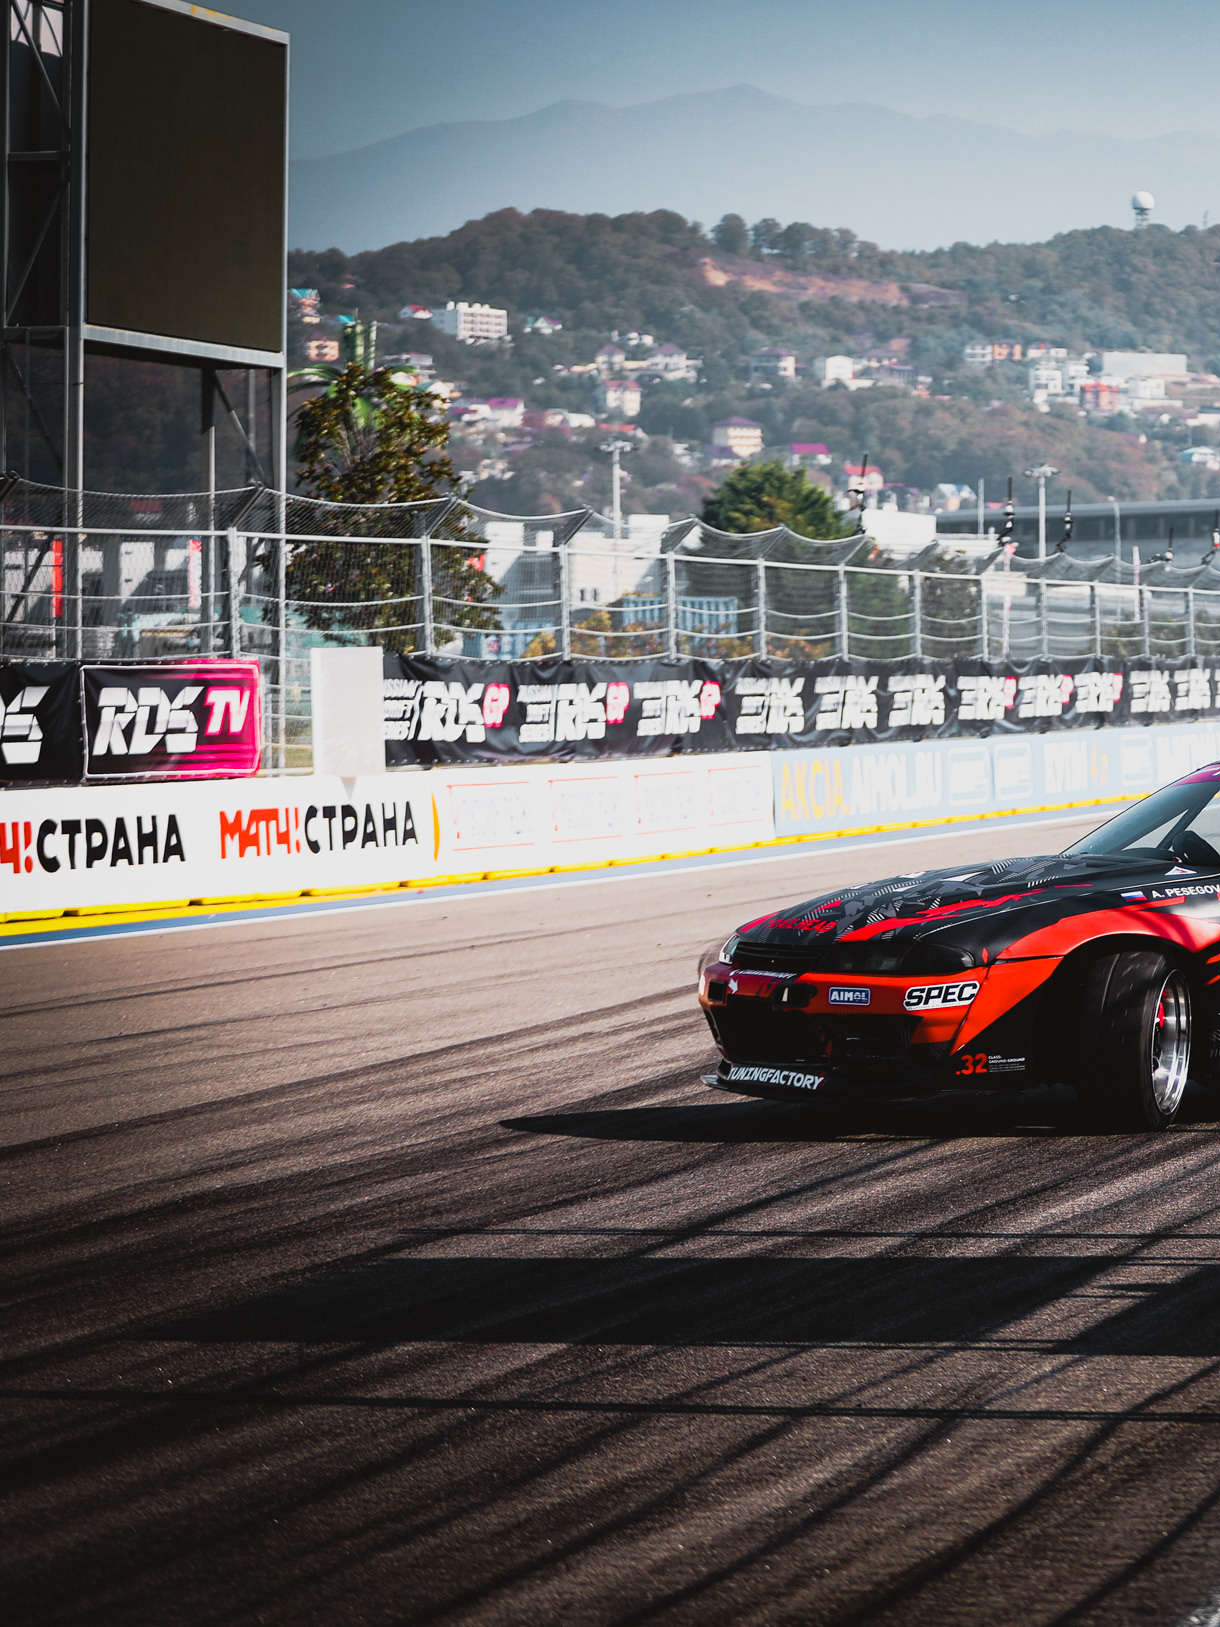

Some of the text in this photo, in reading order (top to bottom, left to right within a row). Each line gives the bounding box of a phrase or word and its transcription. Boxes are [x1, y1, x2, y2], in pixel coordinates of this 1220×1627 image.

[92, 686, 250, 756] RDS TV
[304, 800, 419, 855] СТРАНА
[37, 813, 186, 874] СТРАНА
[1151, 888, 1164, 899] A.
[760, 918, 837, 934] TRAILHEAD
[830, 991, 869, 1002] AIMOL
[904, 982, 978, 1007] SPEC
[727, 1066, 825, 1091] TUNINGFACTORY
